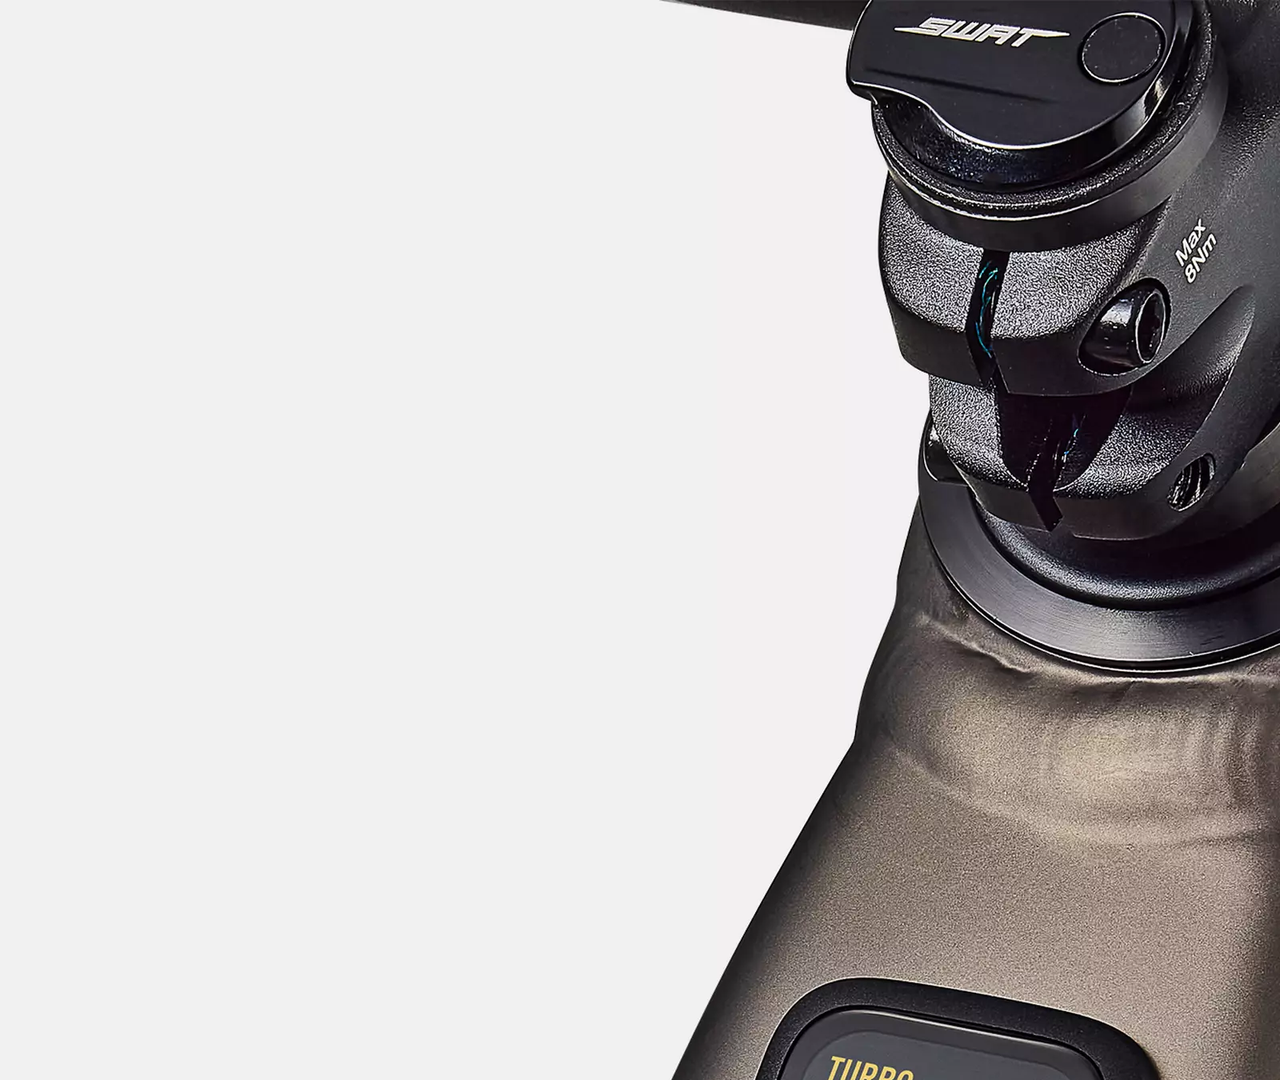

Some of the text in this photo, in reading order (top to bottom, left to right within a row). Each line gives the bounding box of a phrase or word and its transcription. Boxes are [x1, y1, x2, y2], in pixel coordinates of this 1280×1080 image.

[894, 16, 1070, 48] SWAT
[1175, 218, 1207, 267] Max
[1184, 233, 1217, 284] 8Nm
